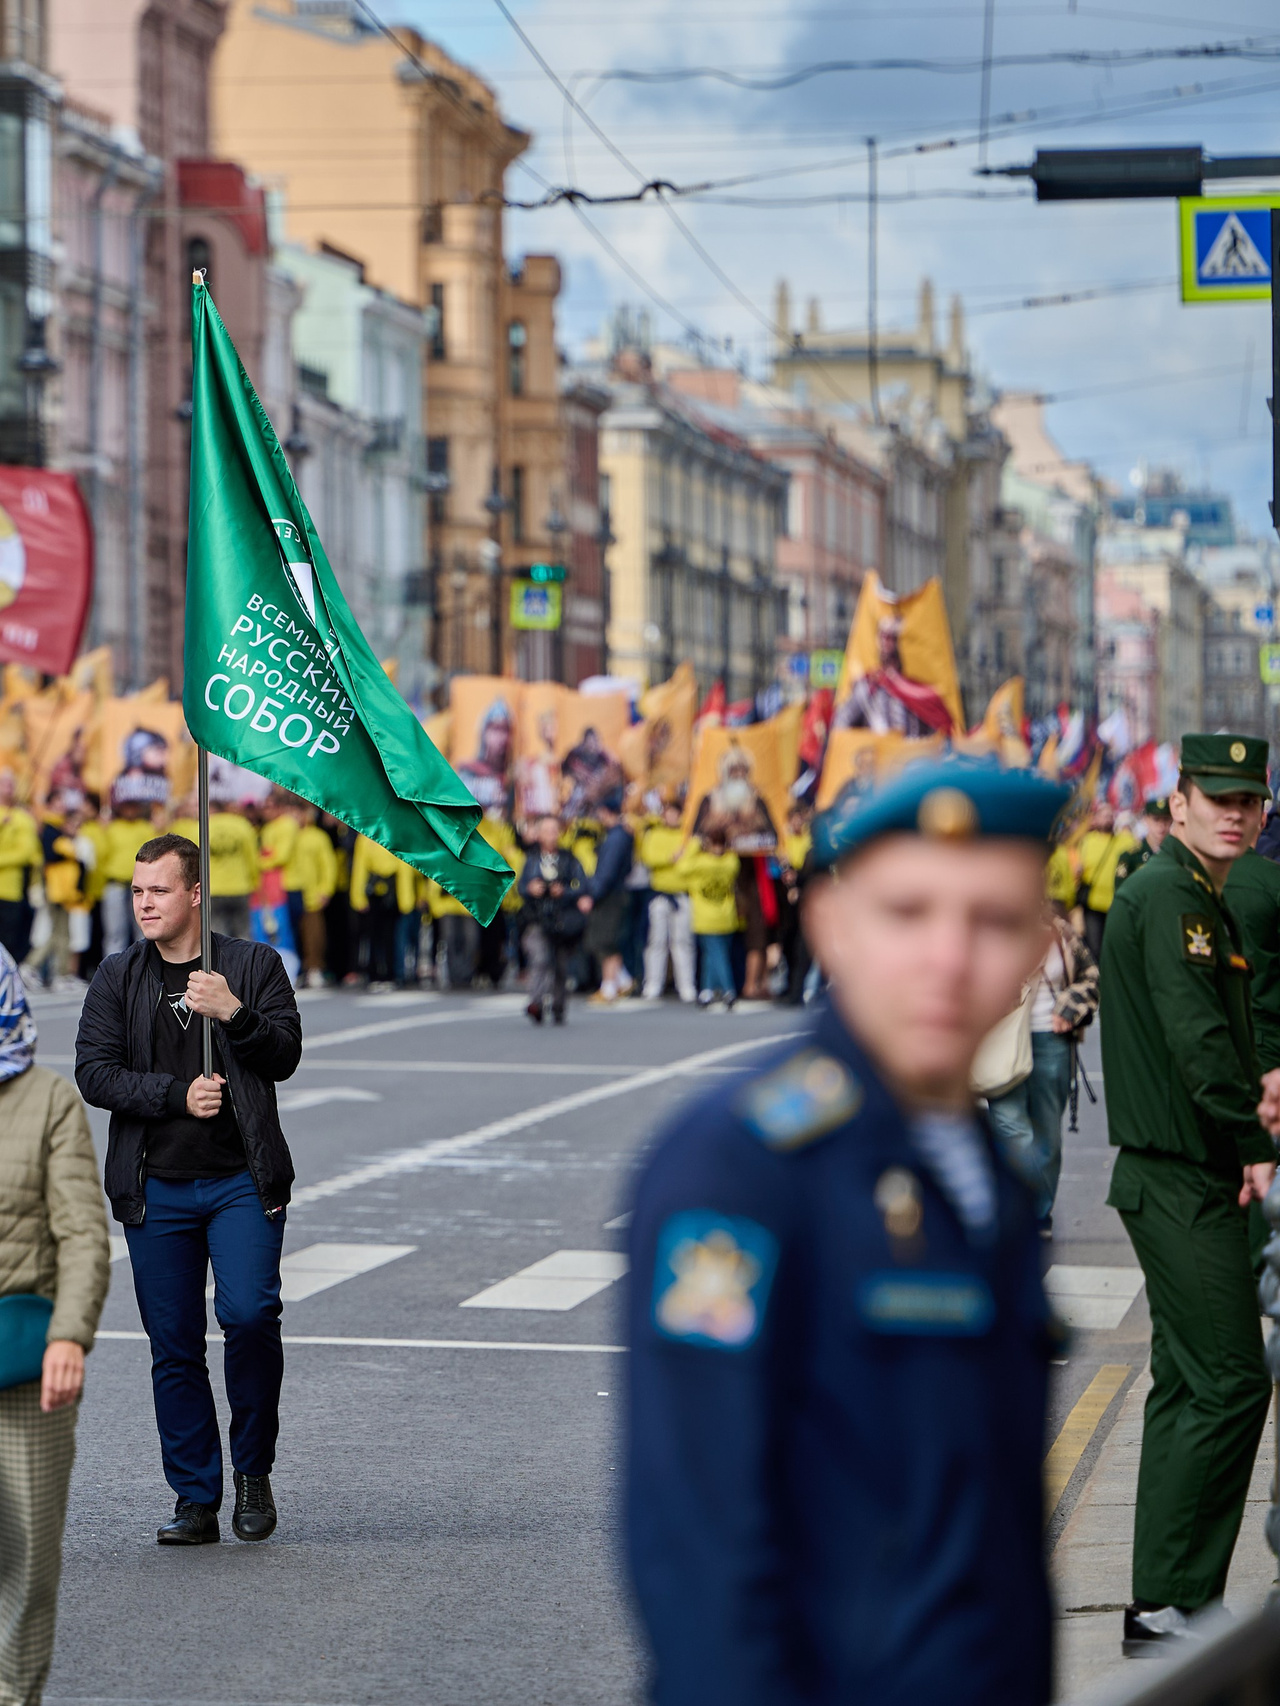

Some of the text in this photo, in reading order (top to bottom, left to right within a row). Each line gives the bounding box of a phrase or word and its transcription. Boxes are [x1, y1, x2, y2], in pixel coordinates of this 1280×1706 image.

[230, 614, 356, 721] РУССКИЙ
[246, 592, 344, 689] ВСЕМИРН
[204, 673, 341, 759] СОБОР
[217, 643, 351, 737] НАРОДНЫЙ
